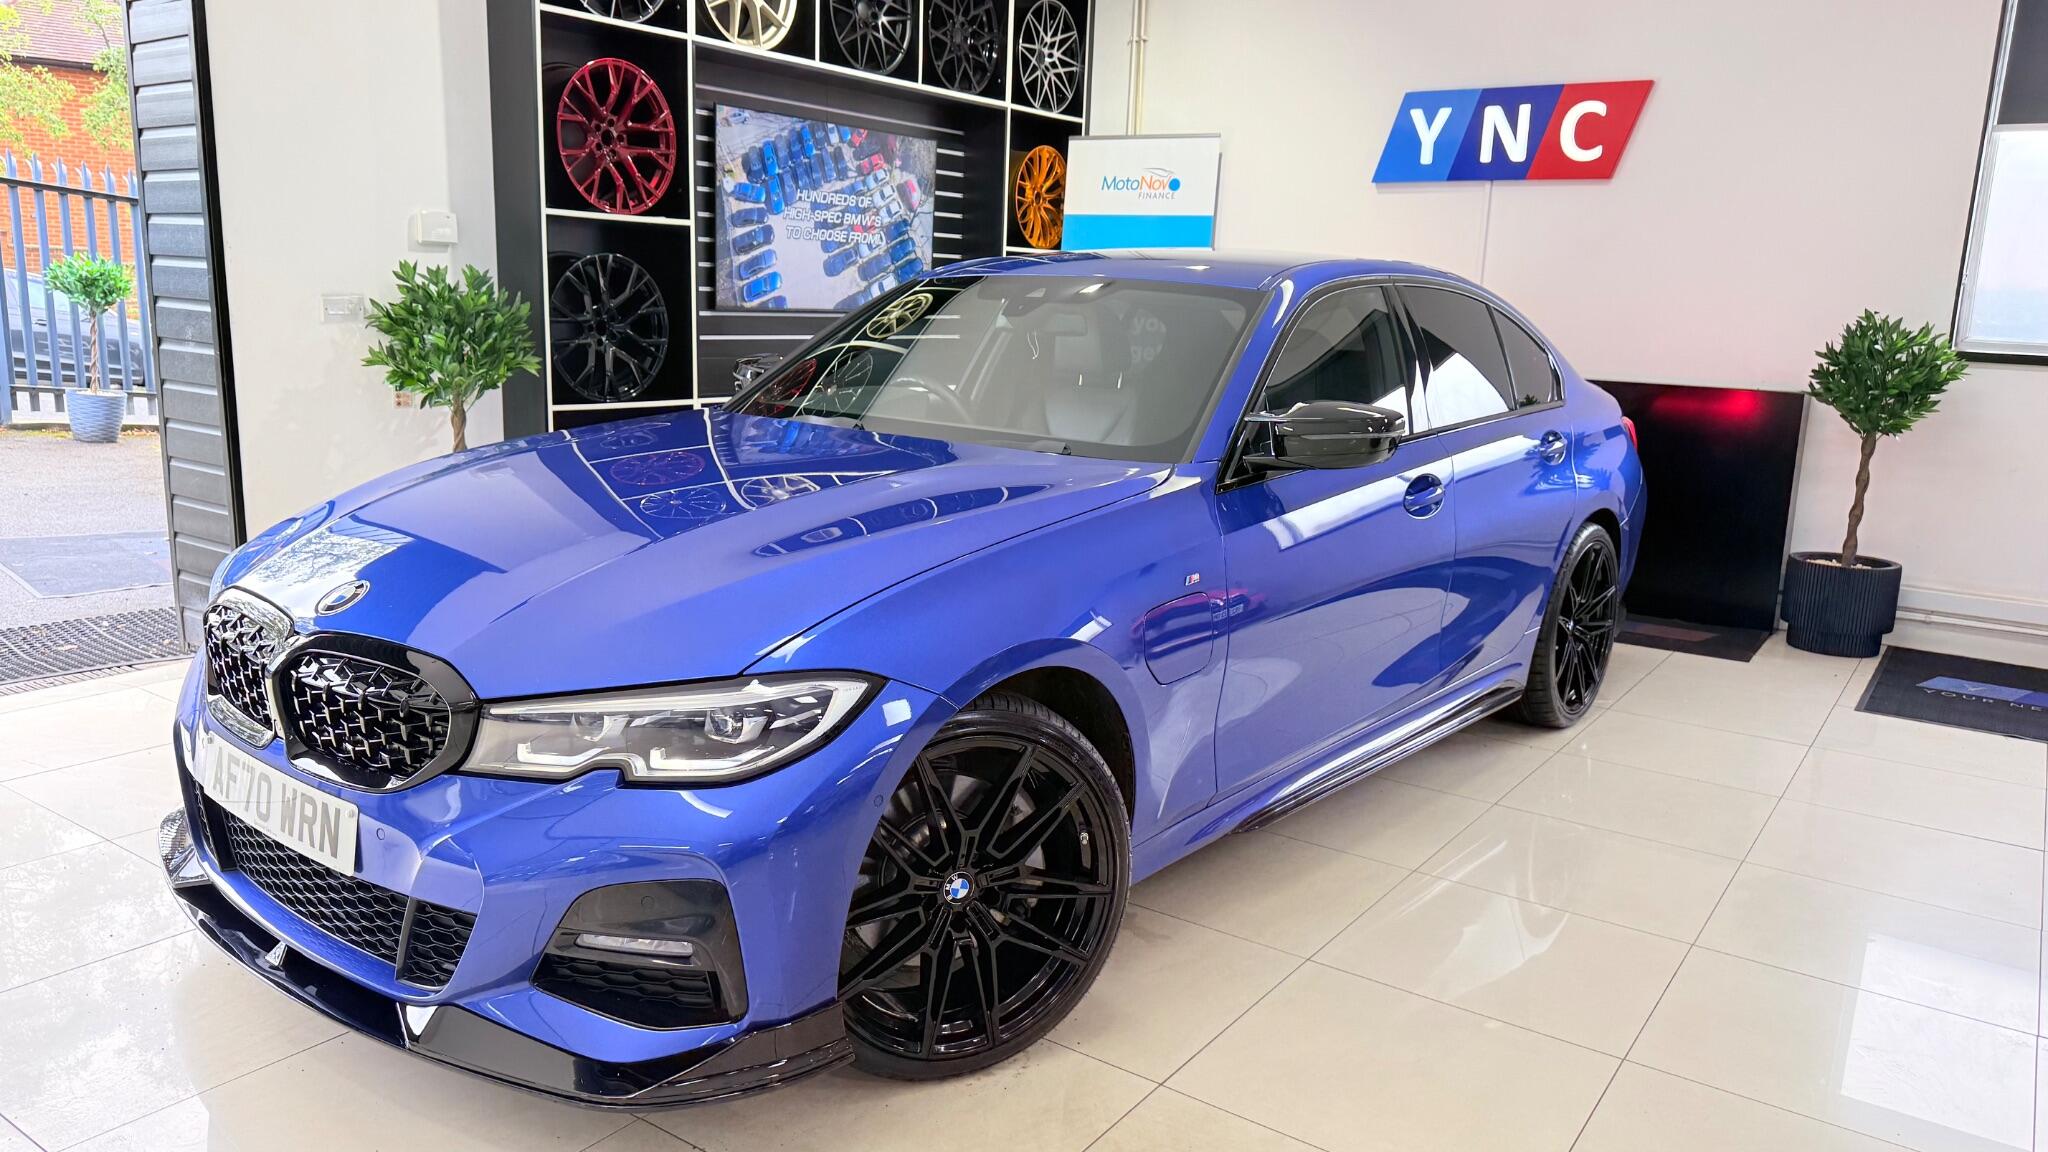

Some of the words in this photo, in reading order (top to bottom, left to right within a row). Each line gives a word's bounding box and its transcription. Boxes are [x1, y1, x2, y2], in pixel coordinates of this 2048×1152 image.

[1410, 100, 1608, 165] YNC
[1101, 175, 1181, 191] MotoNovo
[796, 189, 856, 207] HUNDREDS
[858, 196, 873, 208] OF
[1138, 192, 1176, 200] FINANCE
[783, 207, 842, 224] HIGH-SPEC
[843, 213, 882, 227] BMW'S
[786, 226, 801, 239] TO
[803, 227, 848, 243] CHOOSE
[1923, 688, 1995, 703] YOUR
[212, 746, 272, 822] AF70
[280, 783, 341, 859] WRN
